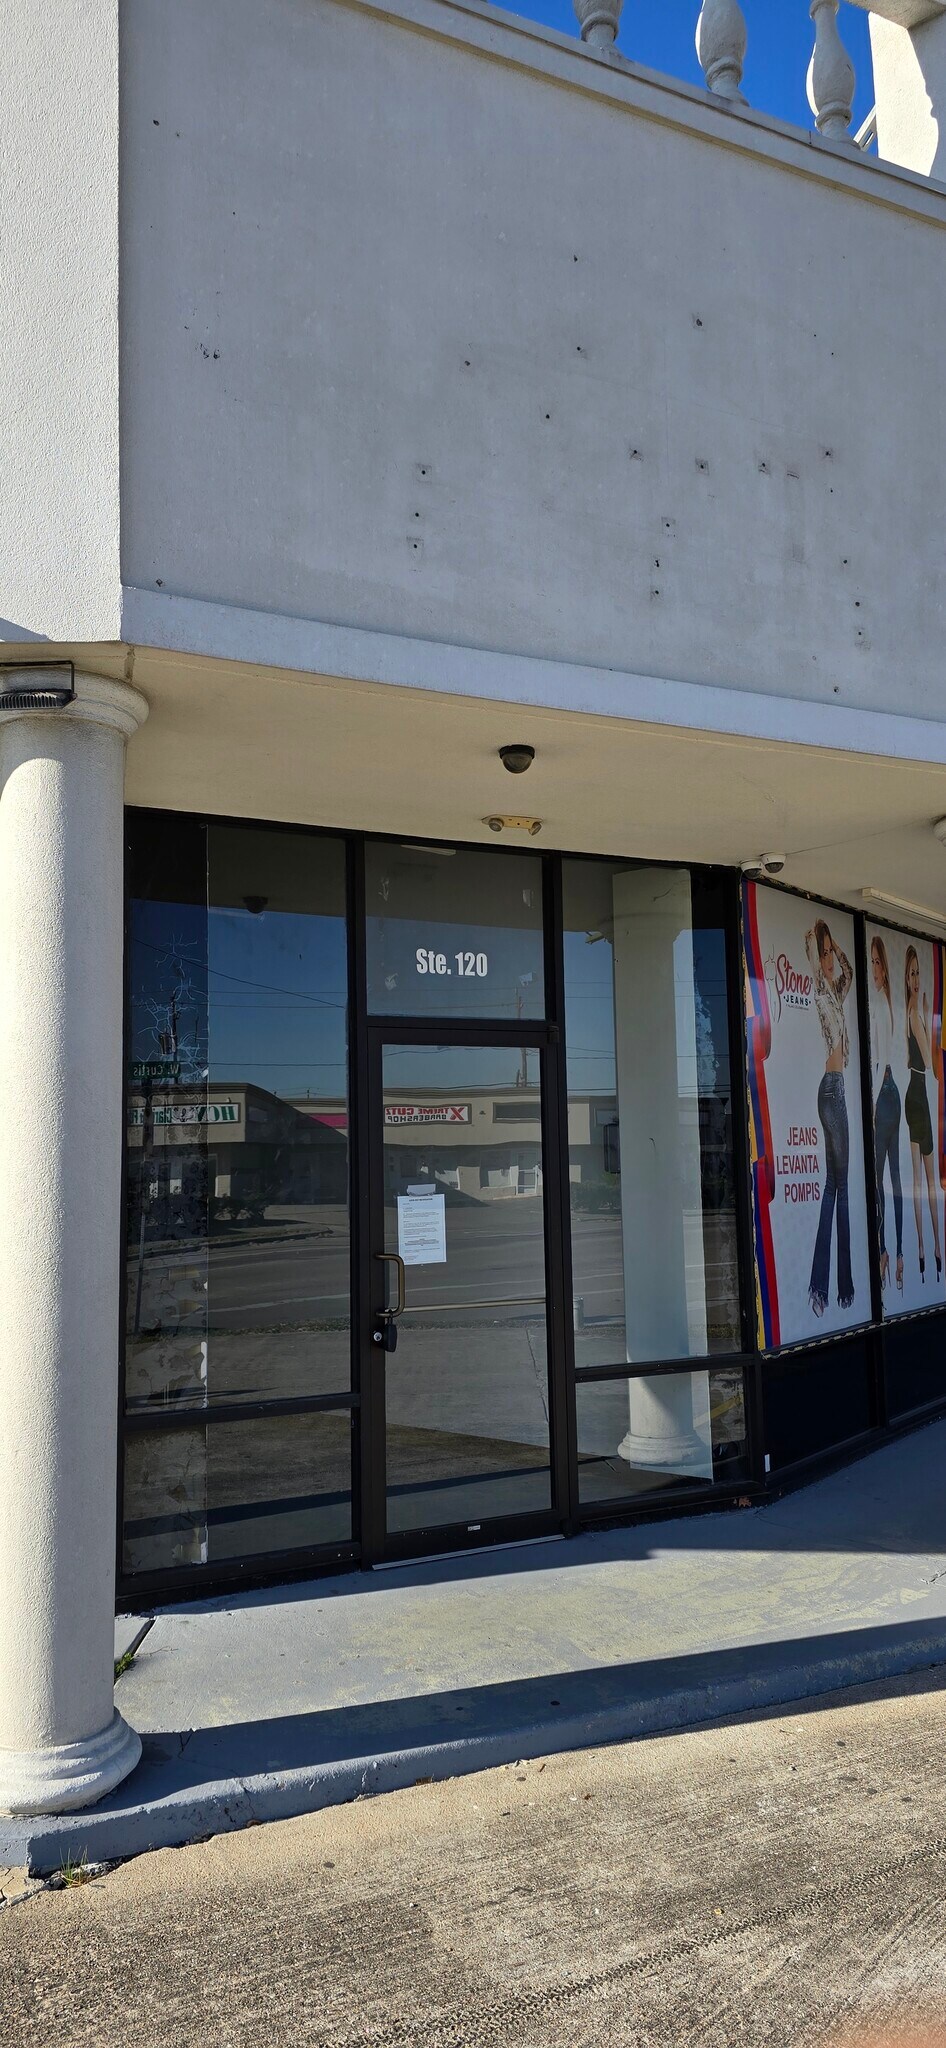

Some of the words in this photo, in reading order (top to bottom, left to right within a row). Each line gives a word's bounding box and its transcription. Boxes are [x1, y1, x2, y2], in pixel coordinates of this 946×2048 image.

[416, 948, 451, 974] Ste.
[454, 952, 488, 977] 120
[777, 953, 811, 996] Stone
[785, 994, 809, 1006] JEANS
[787, 1127, 818, 1146] JEANS
[776, 1154, 820, 1175] LEVANTA
[784, 1182, 820, 1203] POMPIS
